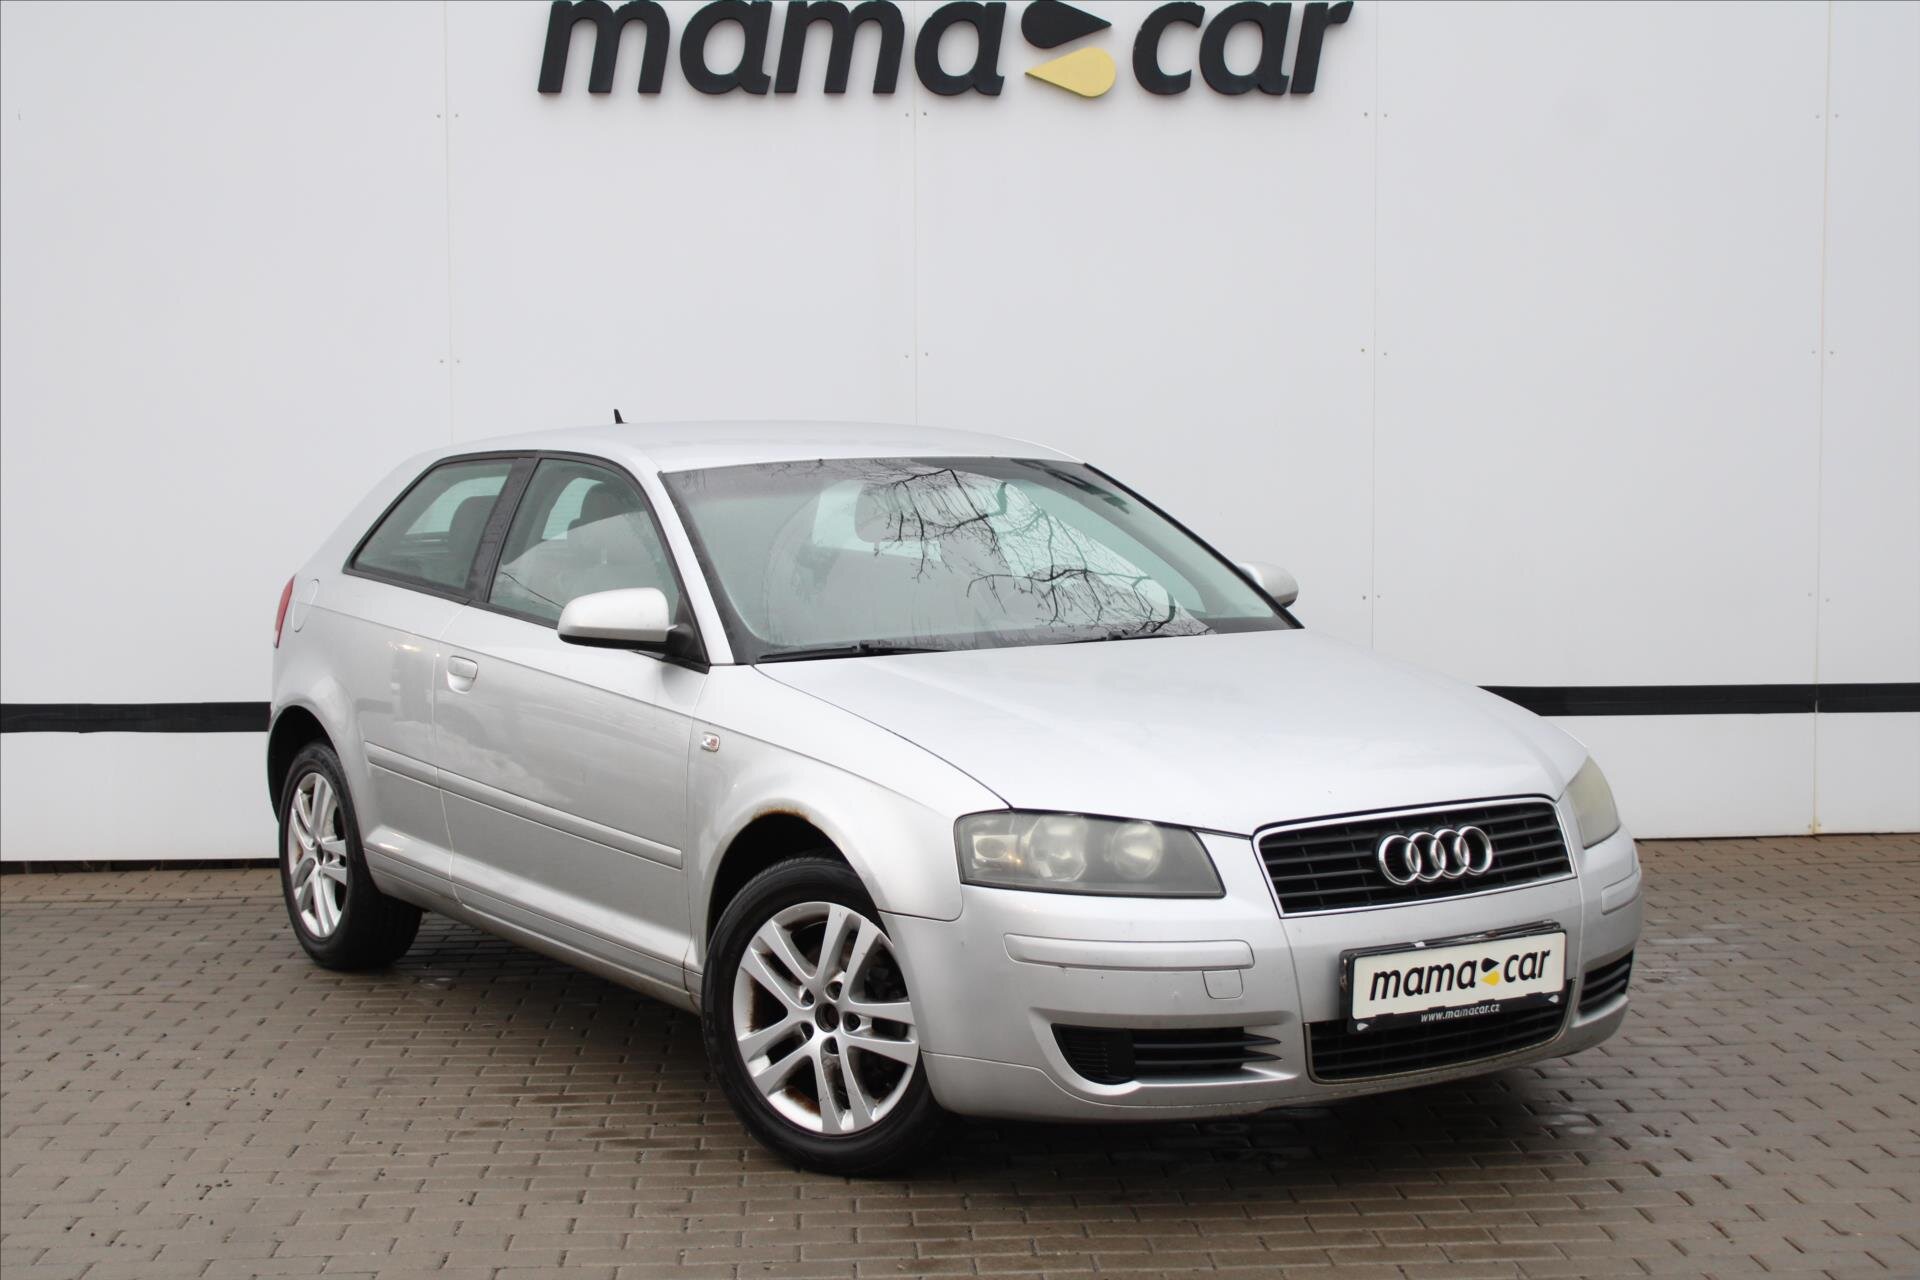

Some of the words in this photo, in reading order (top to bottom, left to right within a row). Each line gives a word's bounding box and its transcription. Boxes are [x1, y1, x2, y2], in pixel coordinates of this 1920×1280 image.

[537, 0, 1007, 95] mama
[1132, 0, 1354, 95] car
[1369, 960, 1477, 1001] mama
[1504, 949, 1551, 983] car
[1420, 1003, 1500, 1023] www.mamacar.cz
